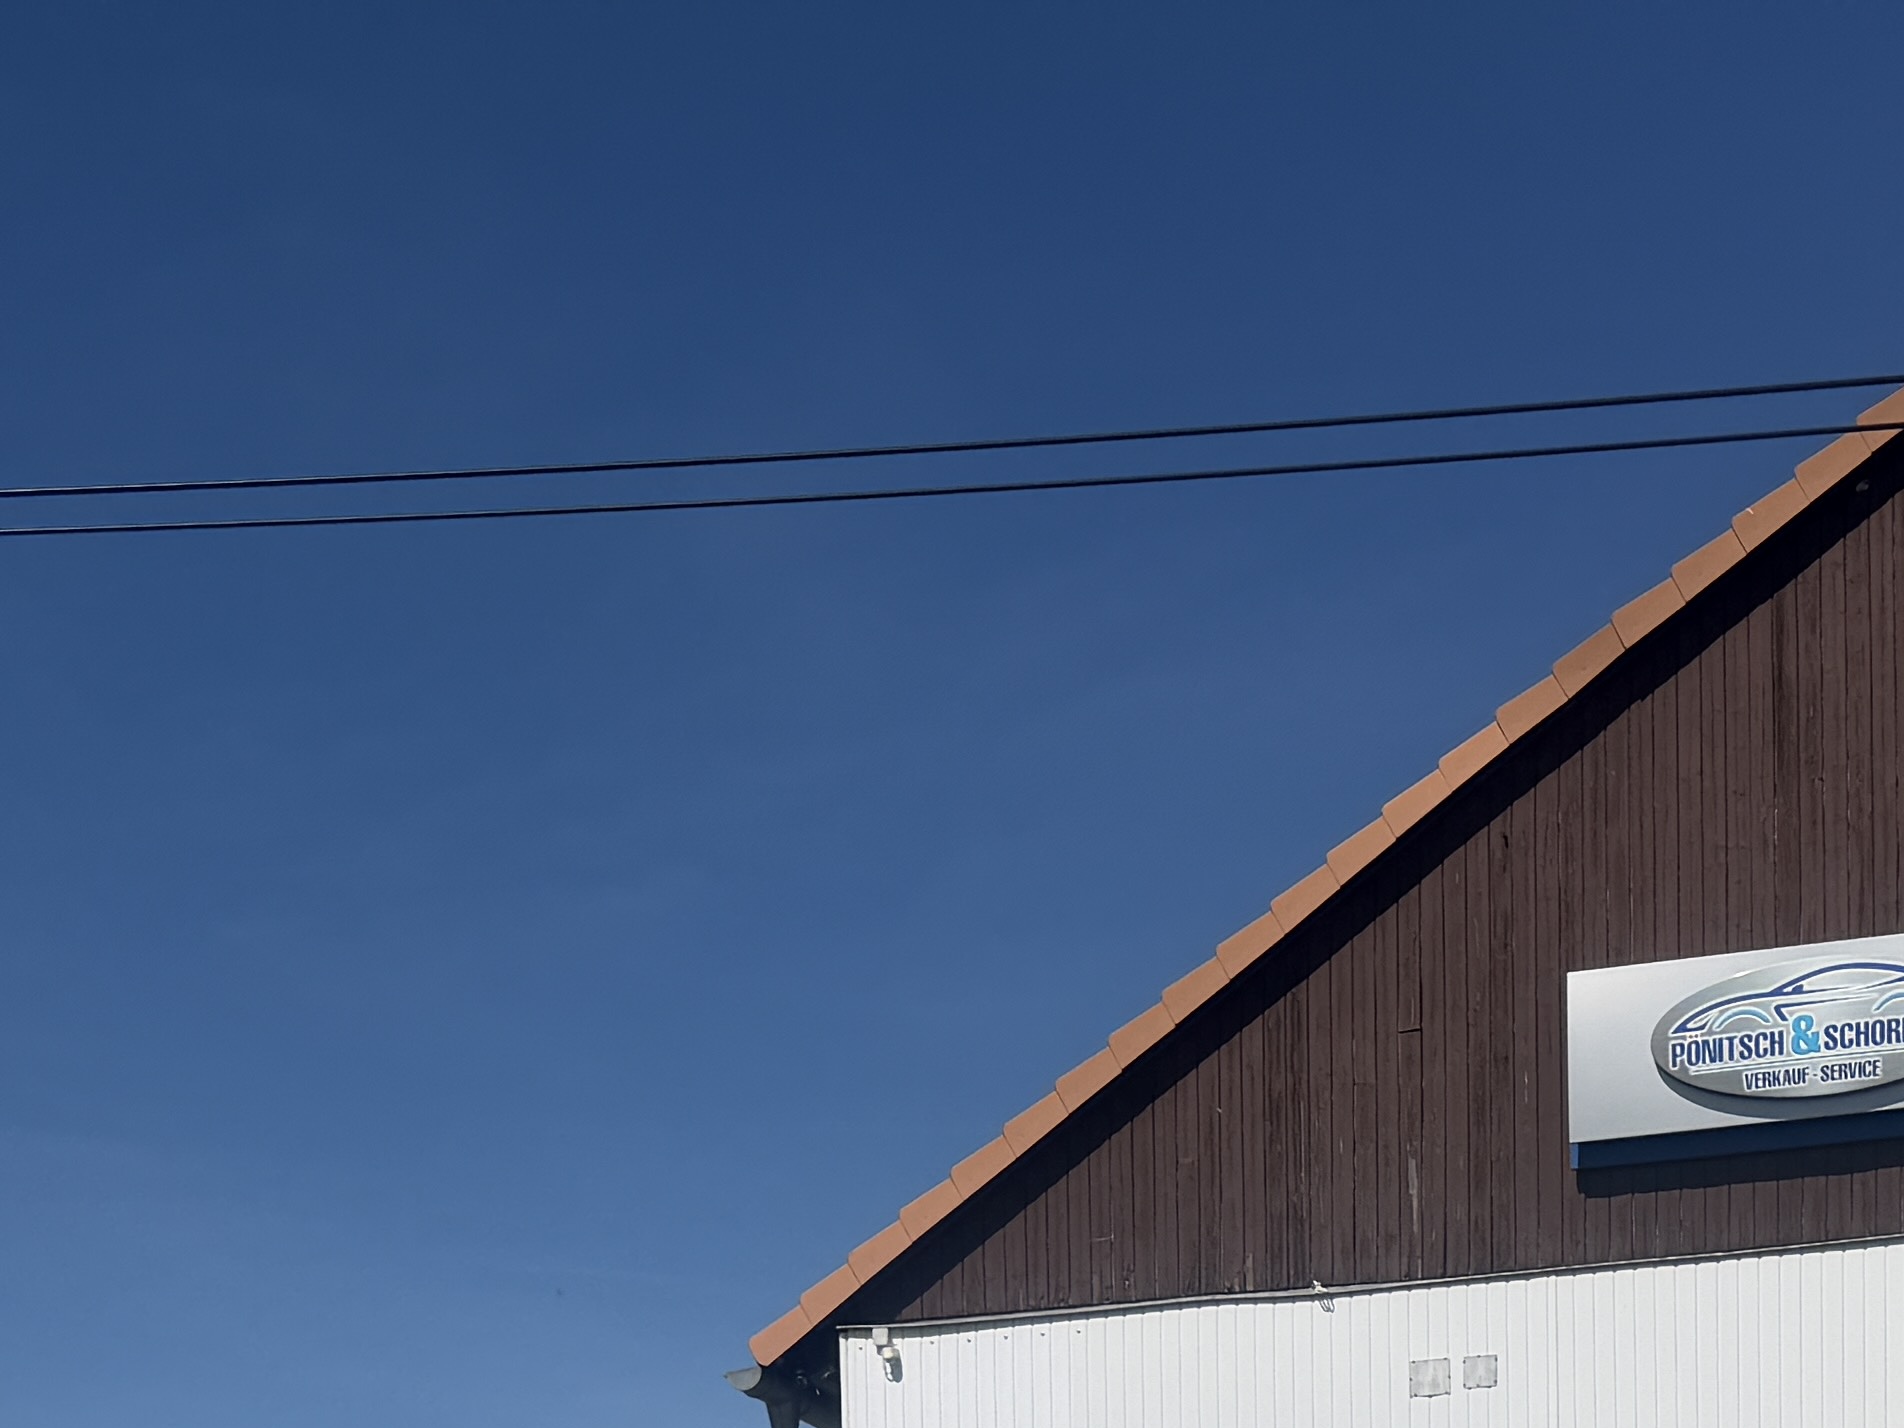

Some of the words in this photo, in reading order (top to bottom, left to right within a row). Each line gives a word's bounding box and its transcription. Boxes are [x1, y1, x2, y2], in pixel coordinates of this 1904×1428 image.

[1671, 1030, 1785, 1068] PÖNITSCH
[1791, 1014, 1821, 1056] &
[1744, 1066, 1810, 1090] VERKAUF
[1820, 1059, 1882, 1082] SERVICE
